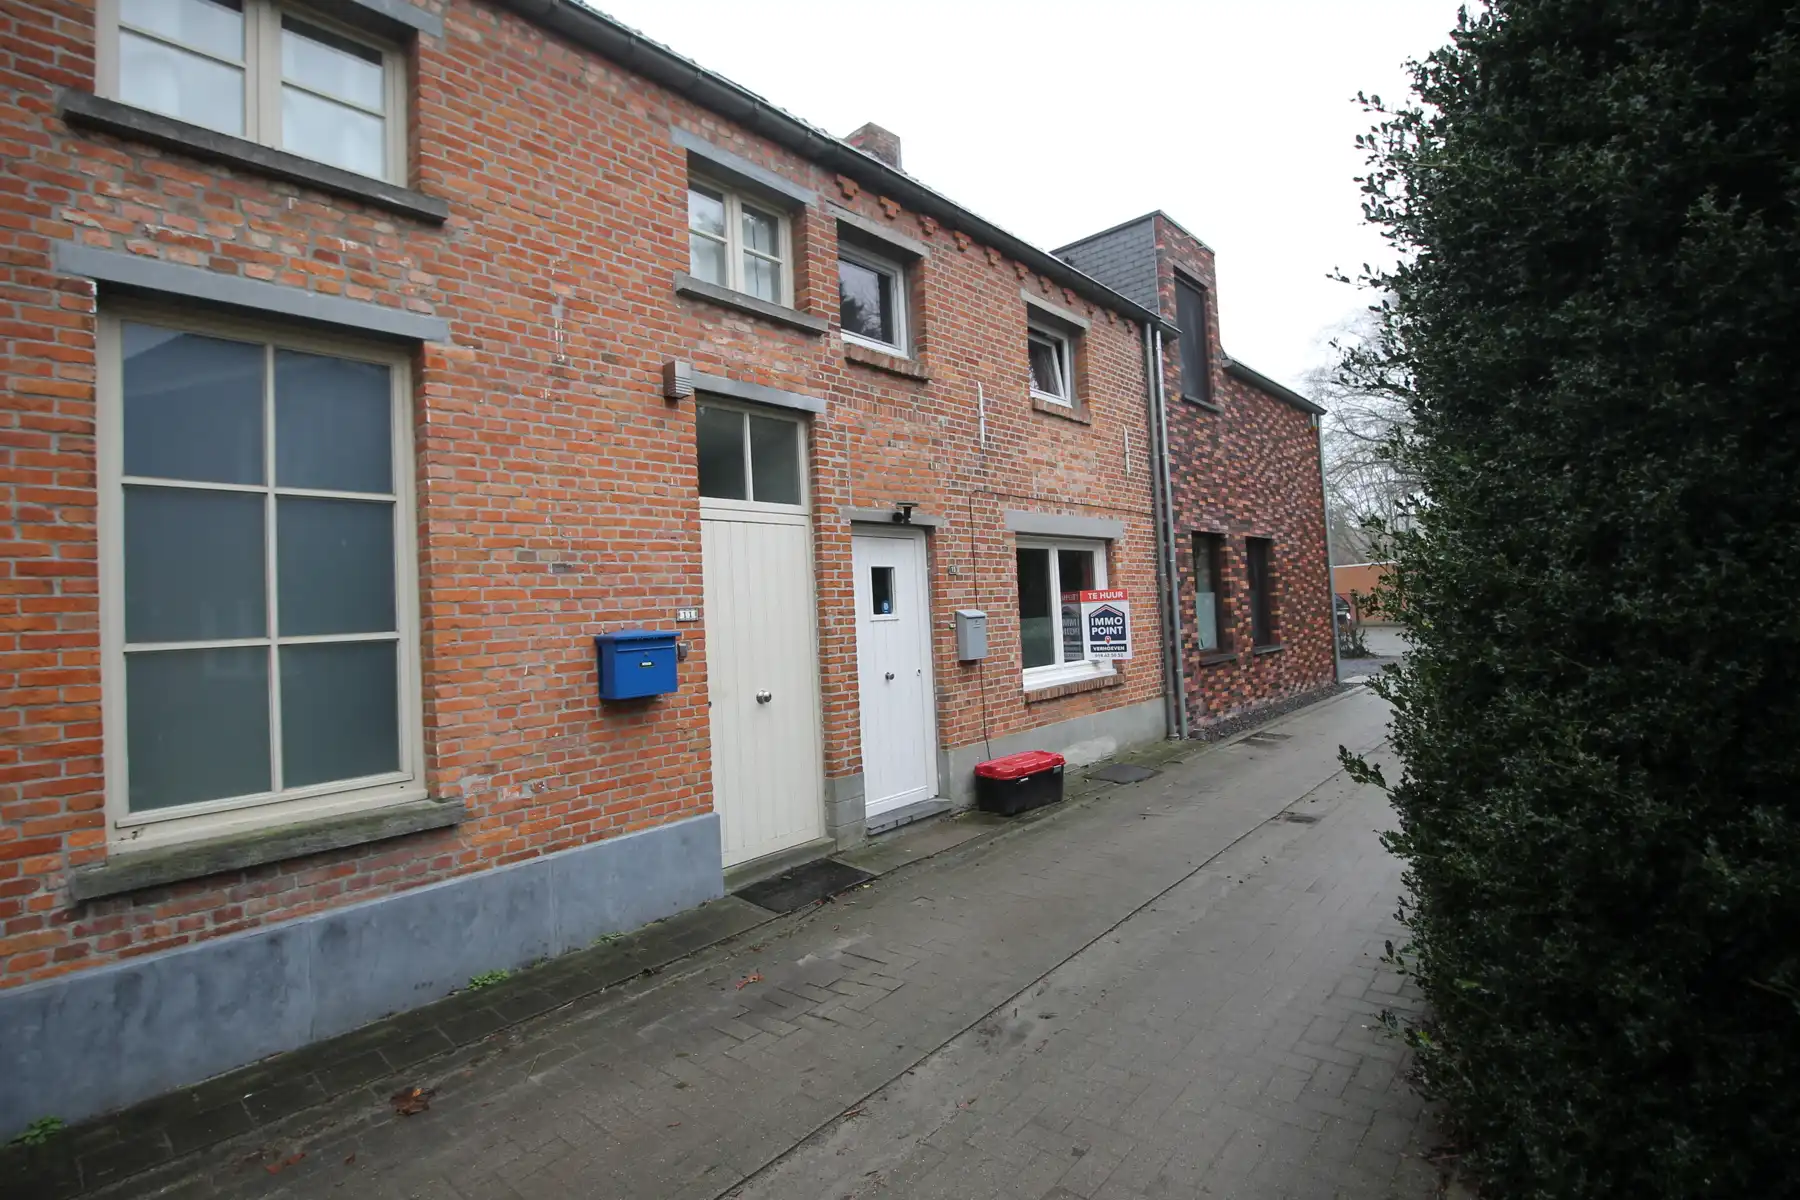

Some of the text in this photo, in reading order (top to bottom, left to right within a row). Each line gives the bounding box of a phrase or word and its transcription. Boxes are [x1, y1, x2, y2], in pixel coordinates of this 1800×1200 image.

[1087, 592, 1098, 600] TE
[1100, 591, 1123, 599] HUUR
[1091, 616, 1123, 626] IMMO
[1091, 626, 1123, 635] POINT
